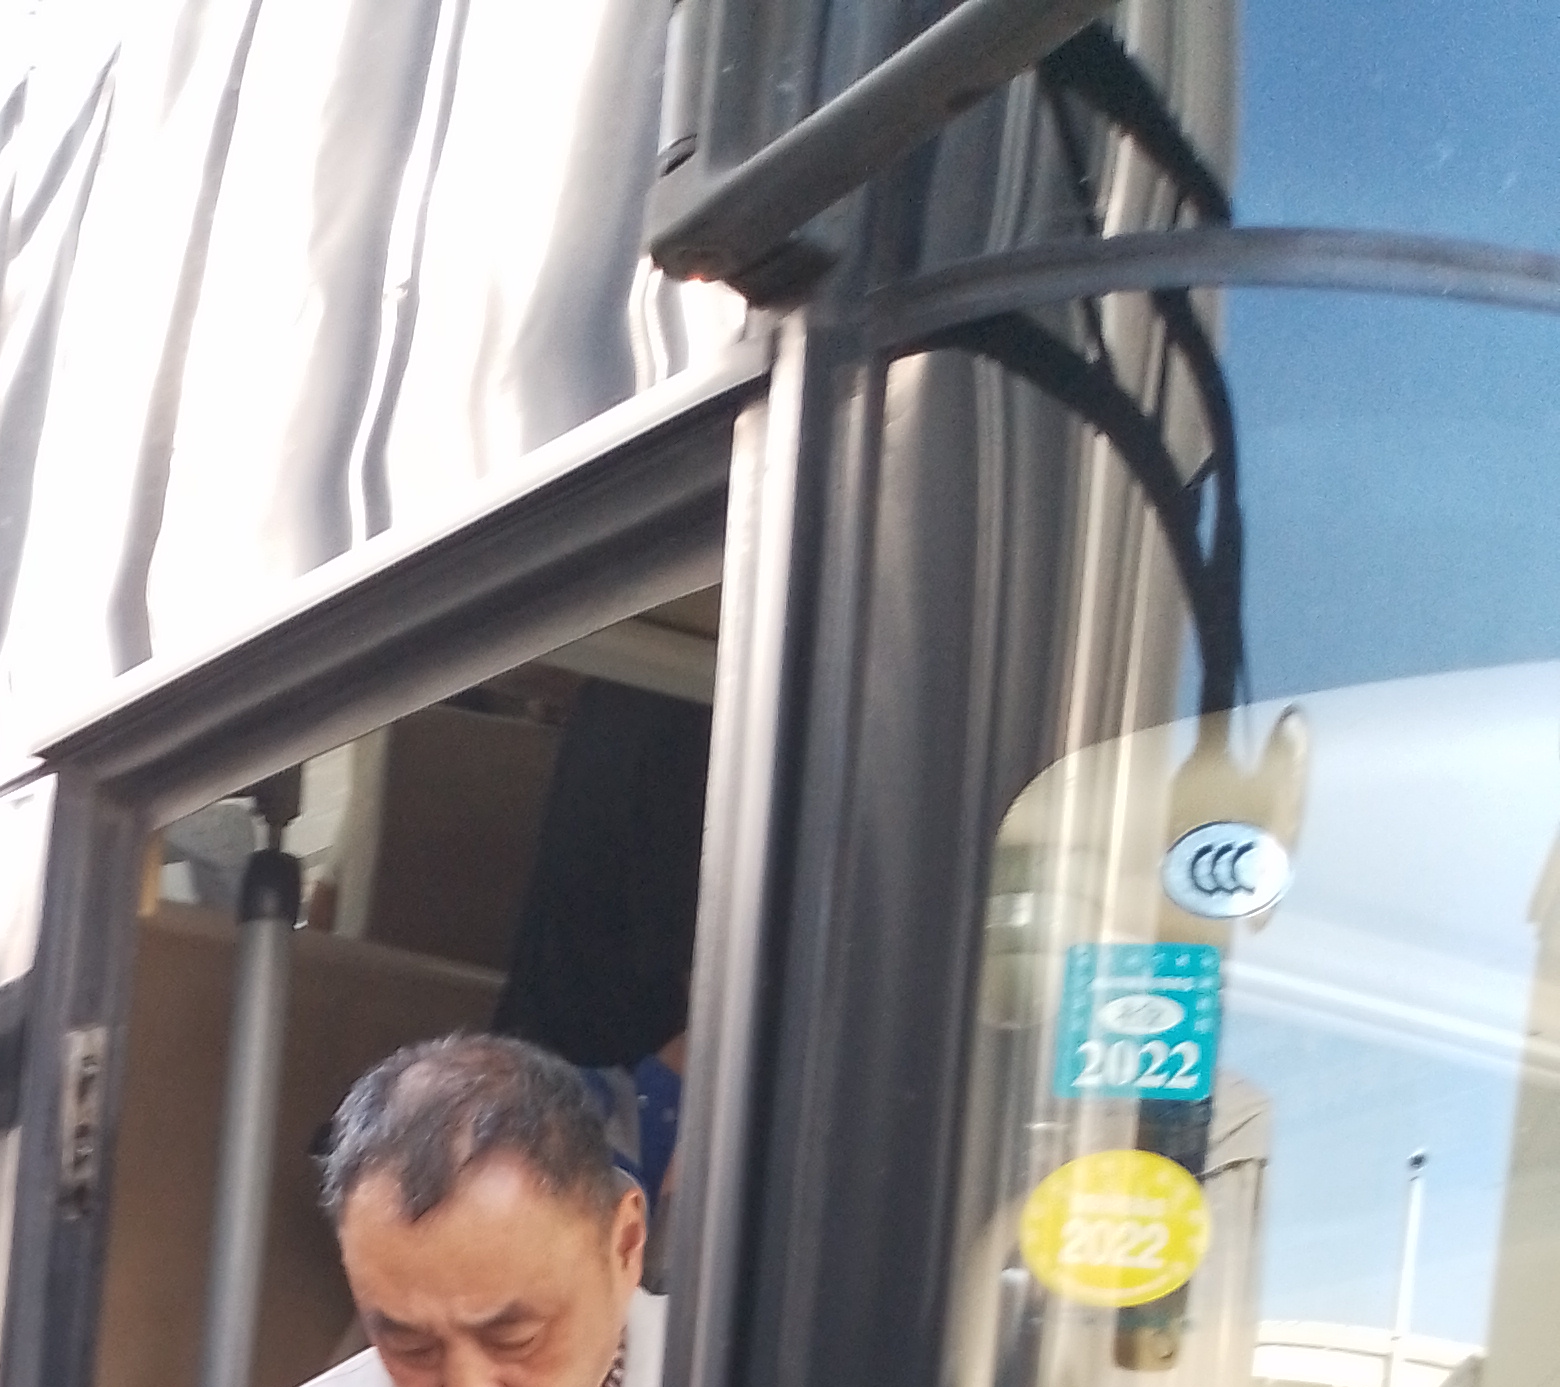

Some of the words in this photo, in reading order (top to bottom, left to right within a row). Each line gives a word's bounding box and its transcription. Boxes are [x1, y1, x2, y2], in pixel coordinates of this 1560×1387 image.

[1190, 841, 1257, 896] CCC
[1070, 1038, 1201, 1090] 2022
[1057, 1217, 1170, 1270] 2022
